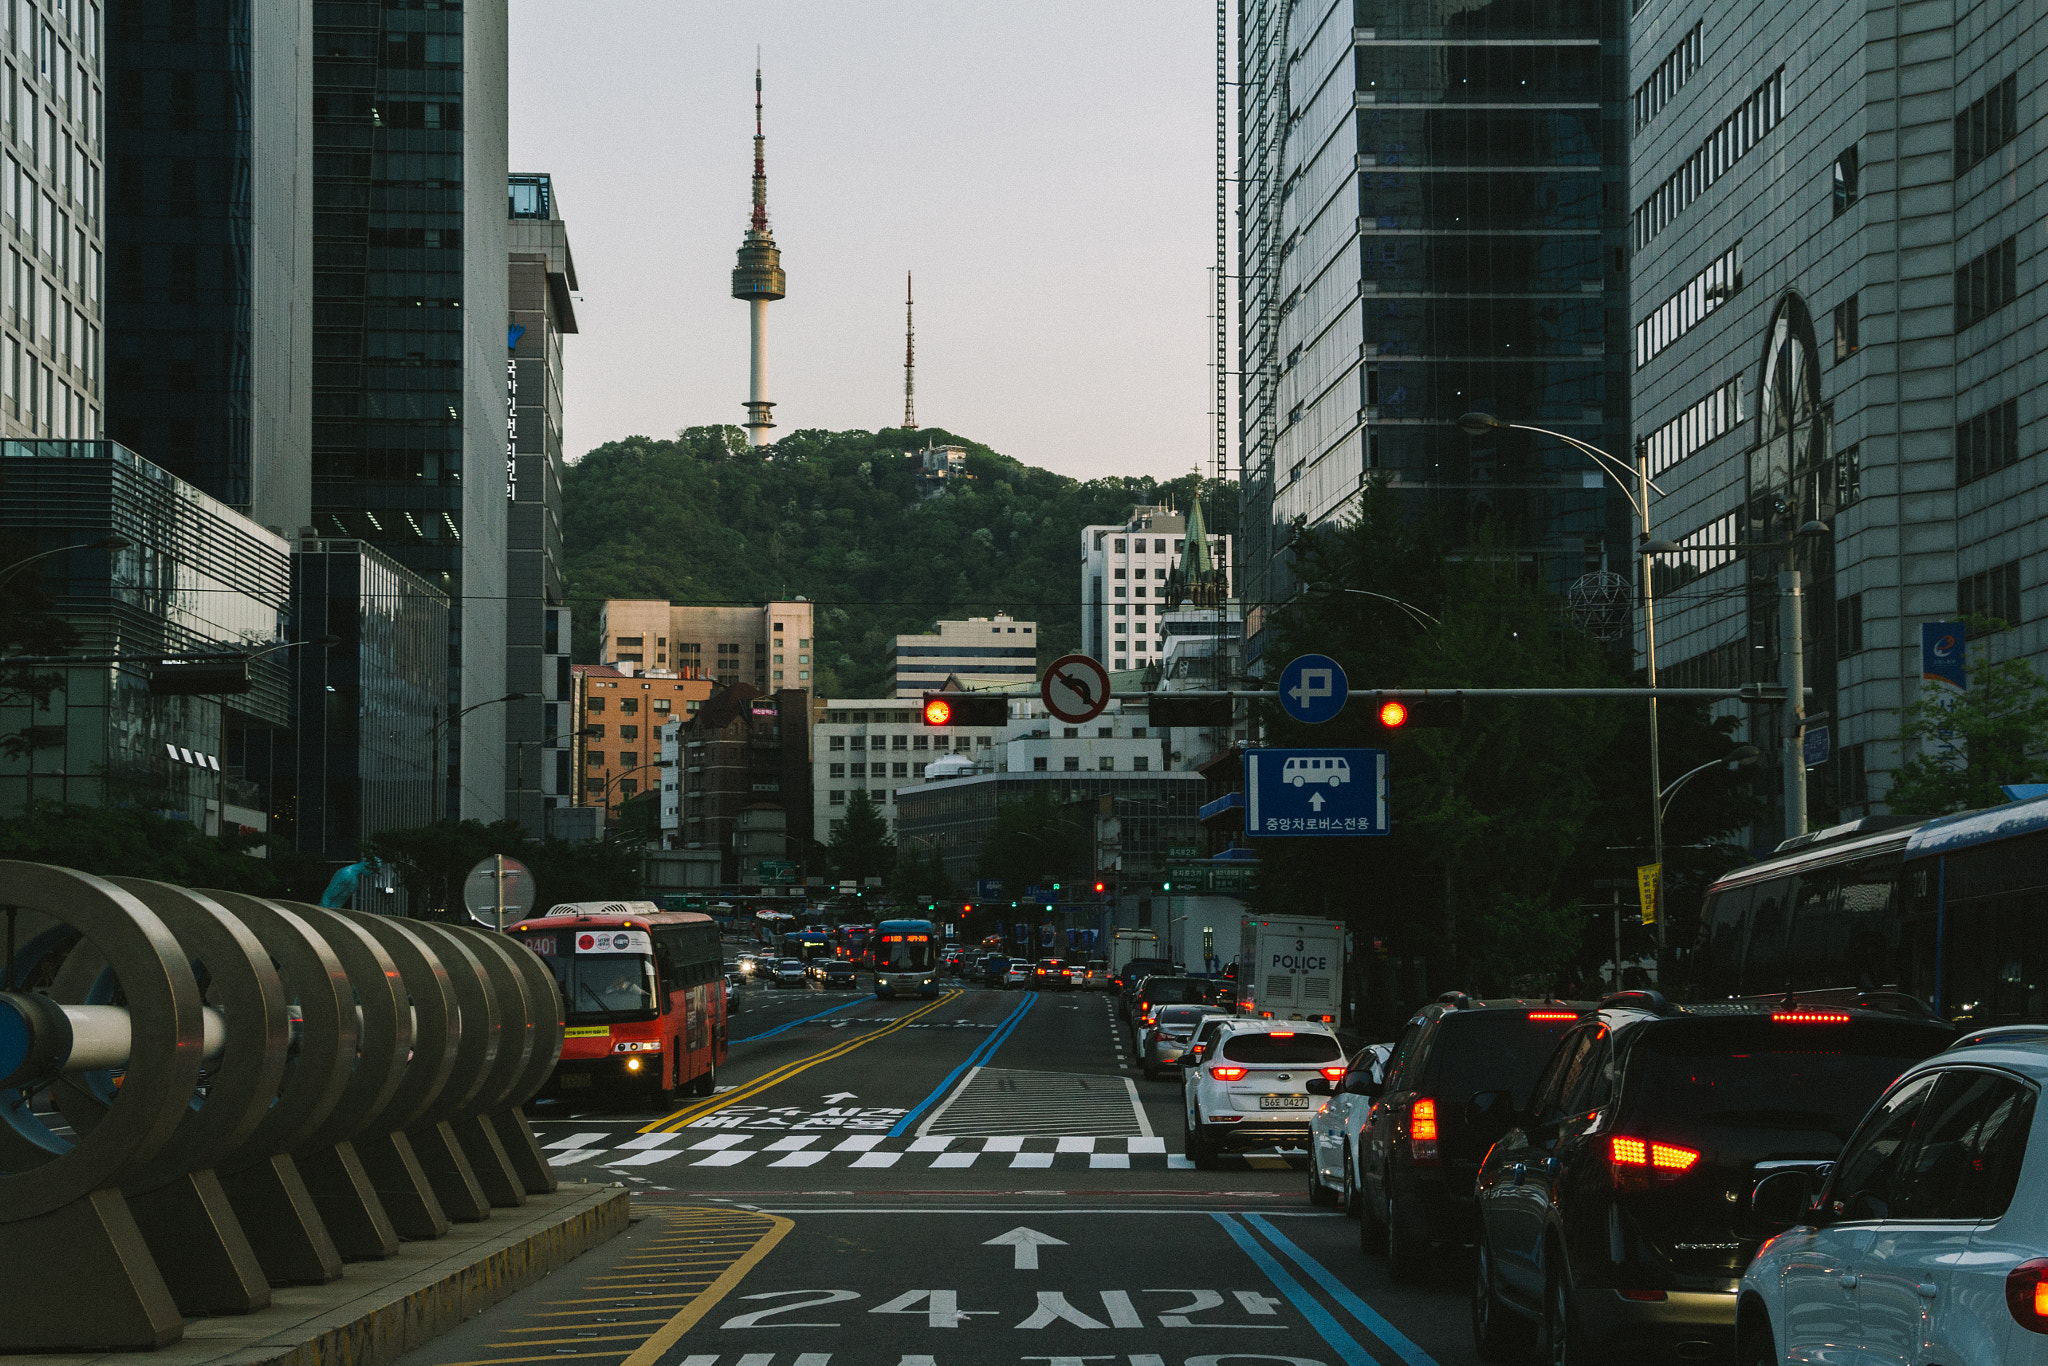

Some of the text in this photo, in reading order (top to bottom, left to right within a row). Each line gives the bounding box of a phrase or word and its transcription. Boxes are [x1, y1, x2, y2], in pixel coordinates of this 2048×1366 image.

[1265, 817, 1370, 831] 중앙차로버스전용
[1295, 939, 1304, 952] 3
[1272, 954, 1327, 970] POLICE
[1284, 1098, 1305, 1107] 0427
[714, 1105, 909, 1118] 24시간
[686, 1116, 896, 1130] 버스전용
[719, 1289, 1290, 1330] 24시간
